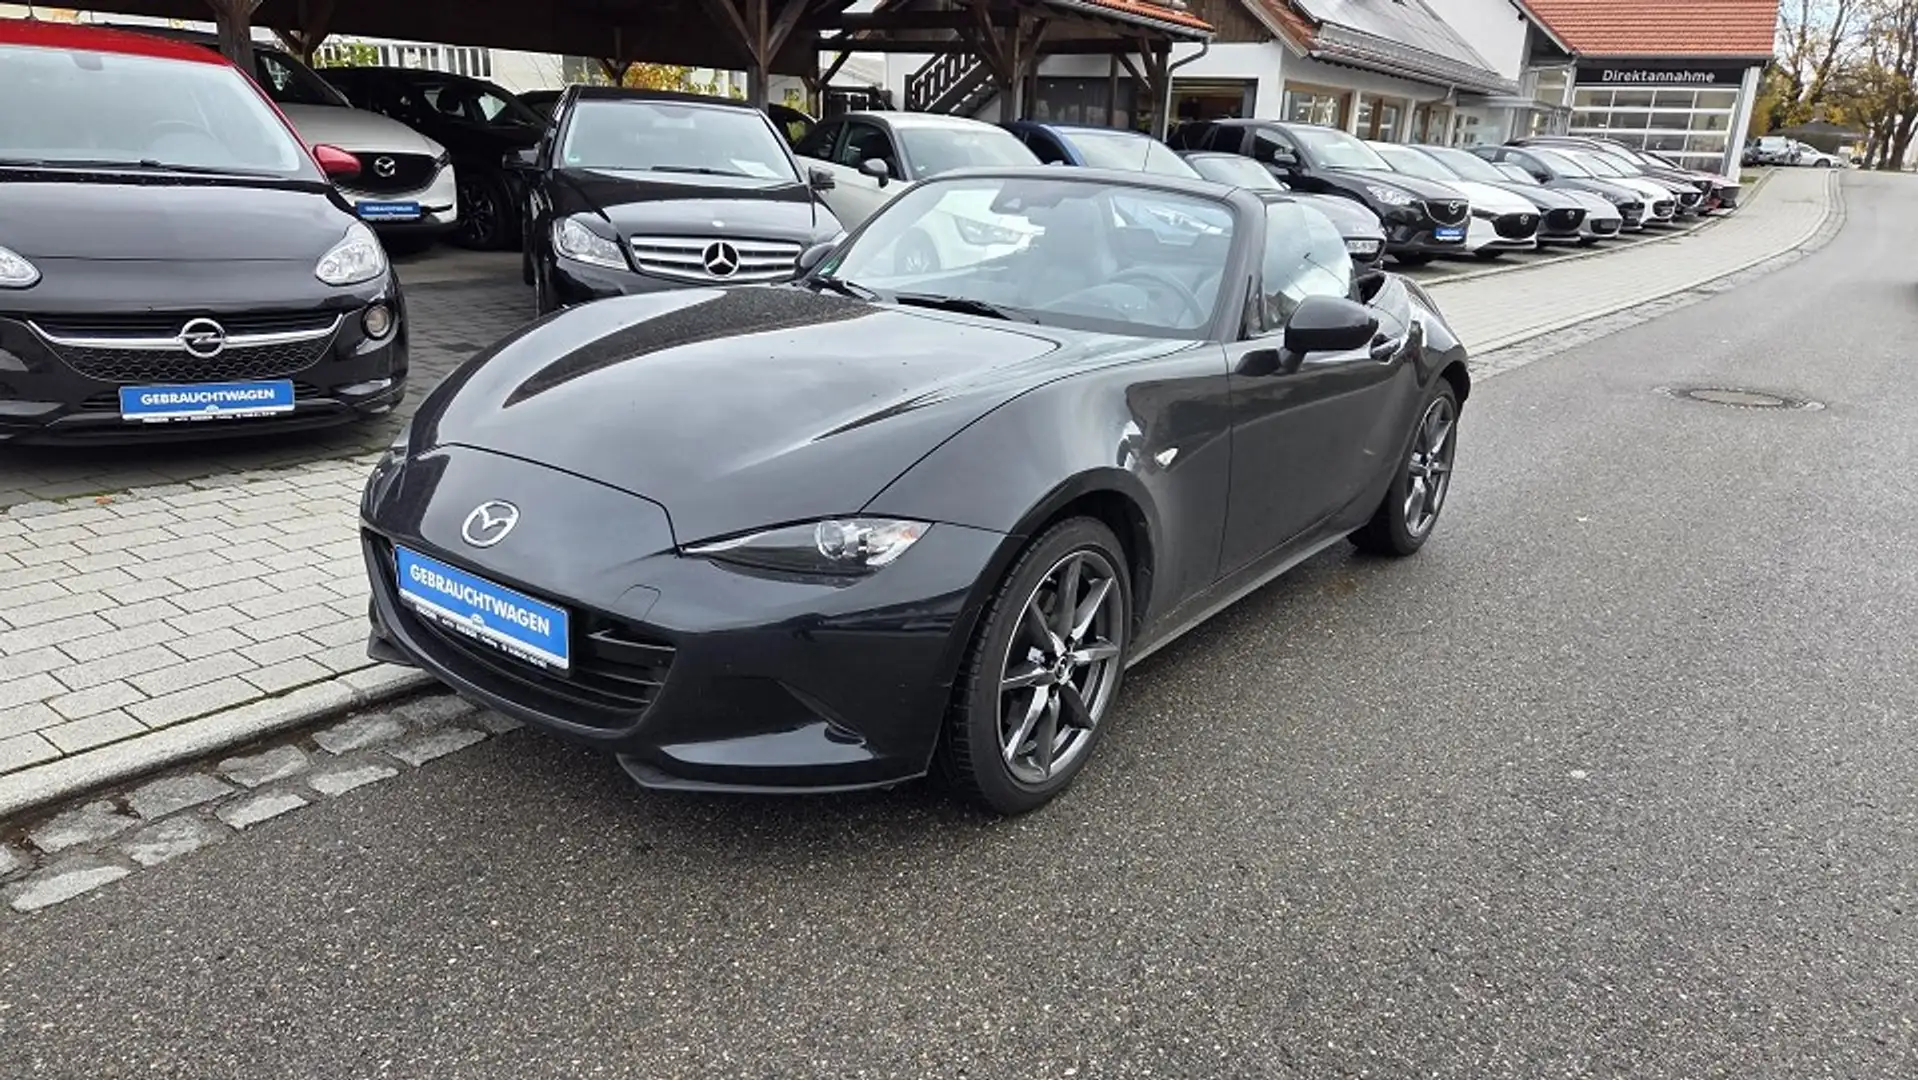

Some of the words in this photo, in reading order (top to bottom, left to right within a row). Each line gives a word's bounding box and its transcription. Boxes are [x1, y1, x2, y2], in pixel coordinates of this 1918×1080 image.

[1602, 70, 1715, 83] Direktannahme
[141, 388, 275, 405] GEBRAUCHTWAGEN
[409, 563, 550, 637] GEBRAUCHTWAGEN
